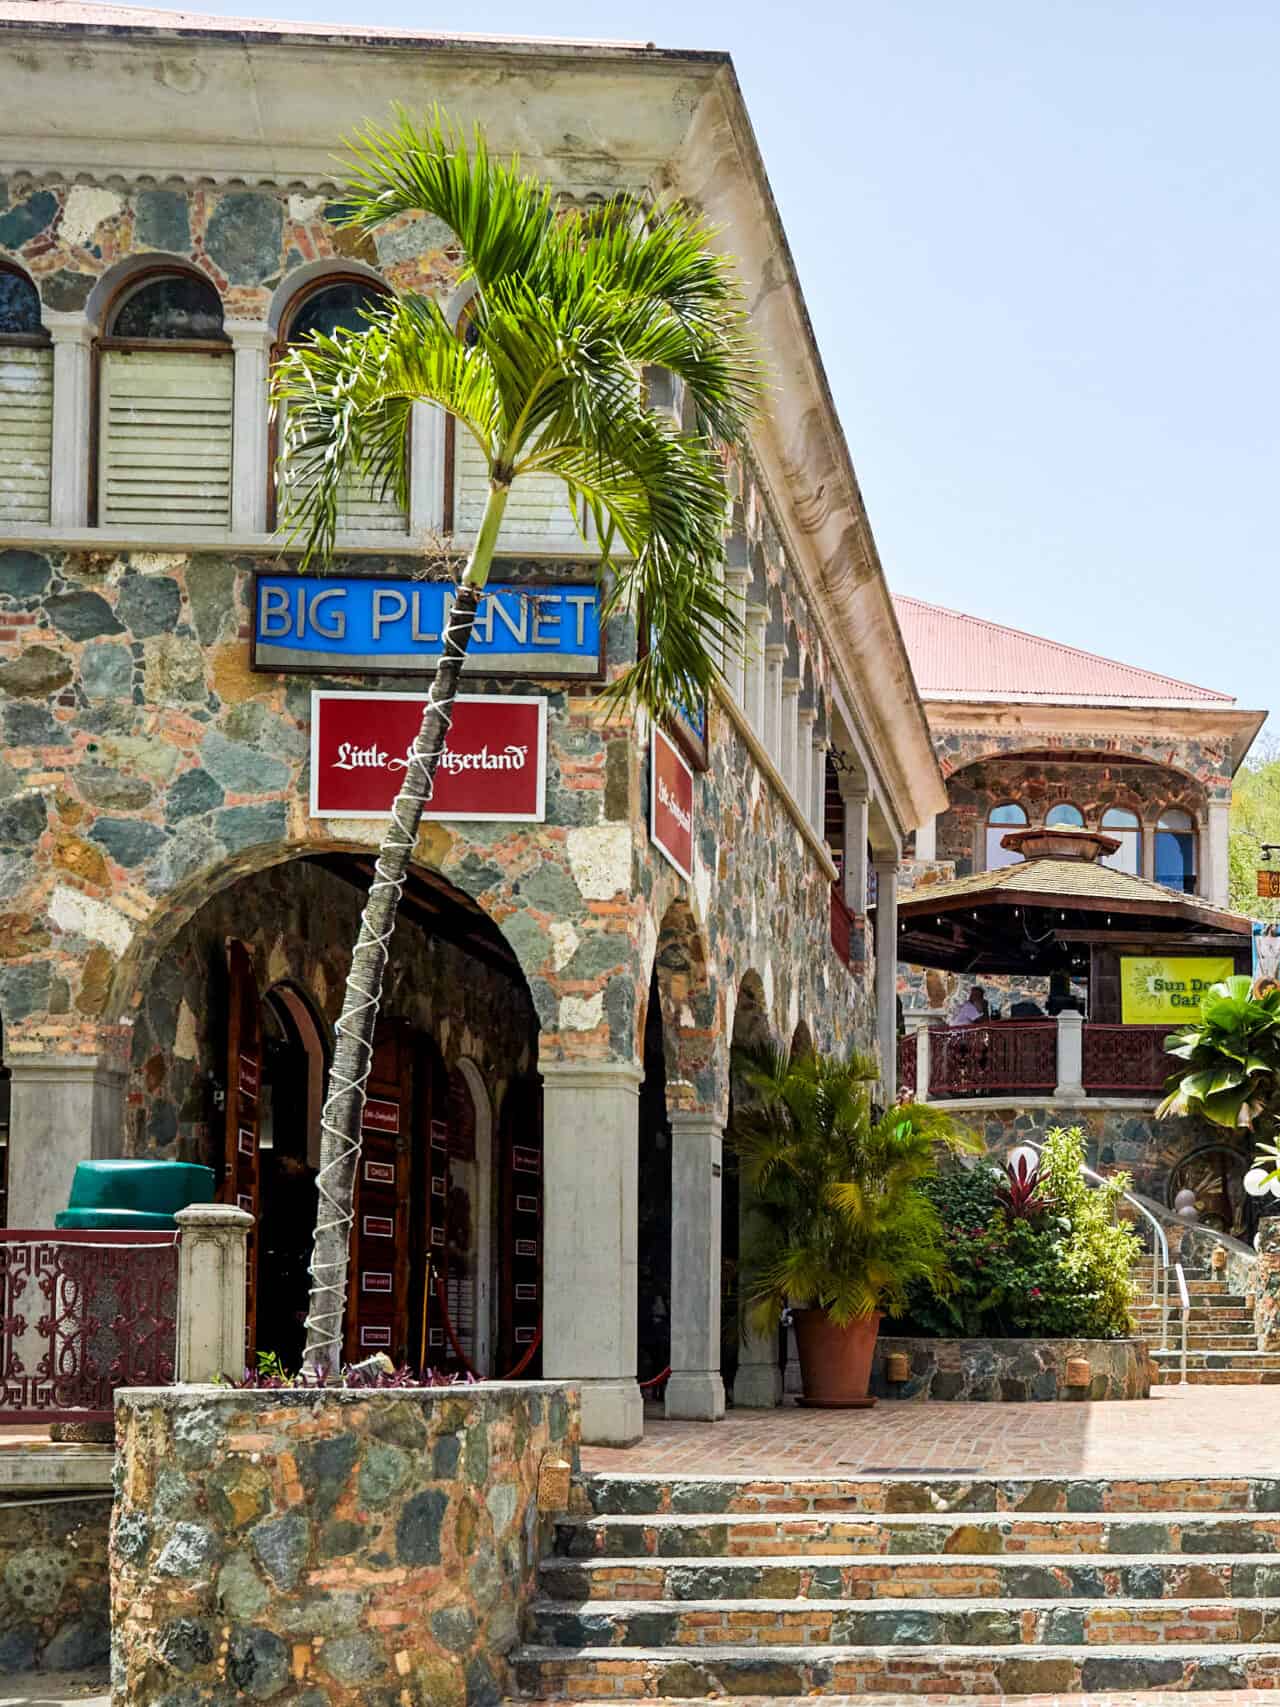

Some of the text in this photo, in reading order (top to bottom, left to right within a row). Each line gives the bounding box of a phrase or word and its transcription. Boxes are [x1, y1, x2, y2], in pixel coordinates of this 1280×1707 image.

[260, 586, 347, 639] BIG
[331, 742, 527, 774] Little Sitzerland
[1154, 978, 1224, 992] Sun Do
[1170, 994, 1201, 1007] Caf
